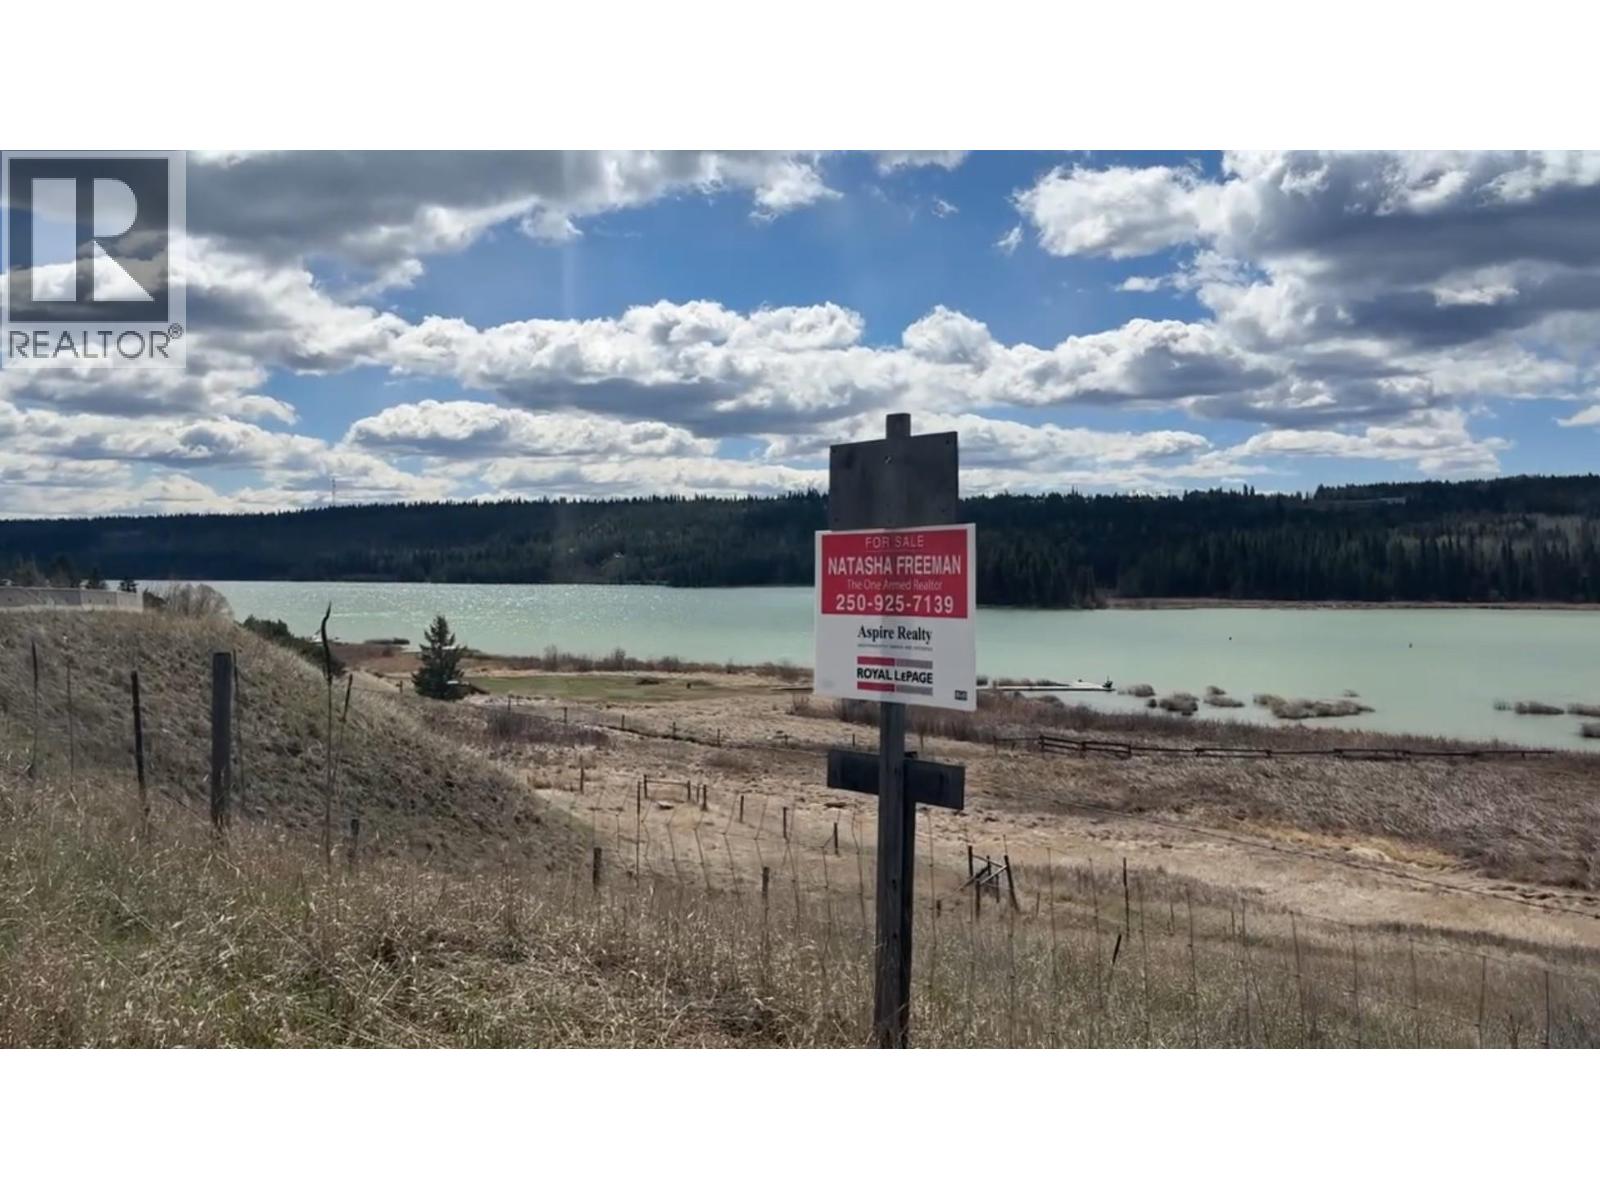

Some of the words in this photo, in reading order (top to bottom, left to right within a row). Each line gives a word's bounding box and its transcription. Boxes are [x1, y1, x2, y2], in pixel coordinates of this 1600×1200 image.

[865, 536, 890, 549] FOR
[895, 535, 925, 548] SALE
[828, 555, 892, 576] NATASHA
[896, 554, 962, 575] FREEMAN
[847, 578, 863, 590] The
[863, 579, 882, 590] One
[883, 578, 911, 591] Armed
[913, 579, 943, 591] Realtor
[835, 593, 954, 614] 250-925-7139
[857, 624, 895, 642] Aspire
[897, 625, 933, 645] Realty
[857, 667, 892, 681] ROYAL
